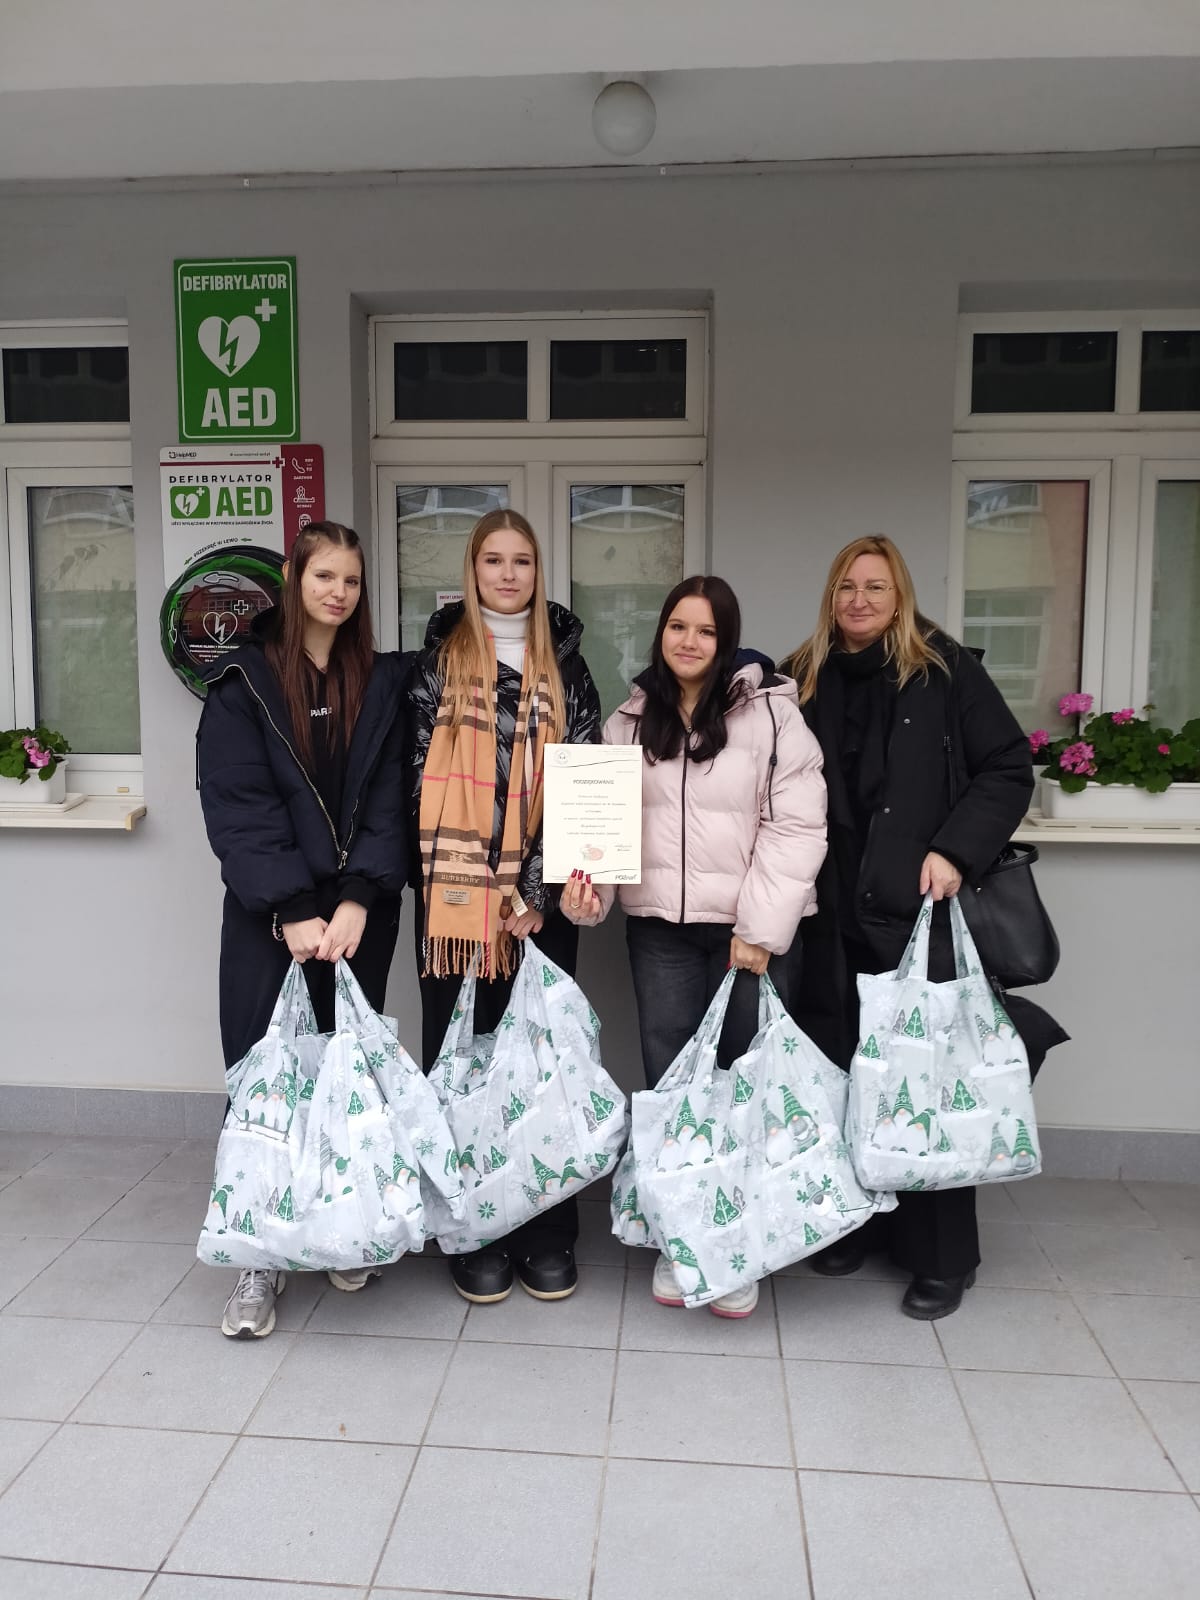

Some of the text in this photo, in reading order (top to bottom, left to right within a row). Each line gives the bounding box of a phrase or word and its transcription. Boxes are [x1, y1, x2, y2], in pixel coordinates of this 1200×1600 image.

[183, 274, 287, 291] DEFIBRYLATOR
[201, 387, 277, 427] AED
[169, 474, 272, 483] DEFIBRYLATOR
[215, 486, 273, 517] AED
